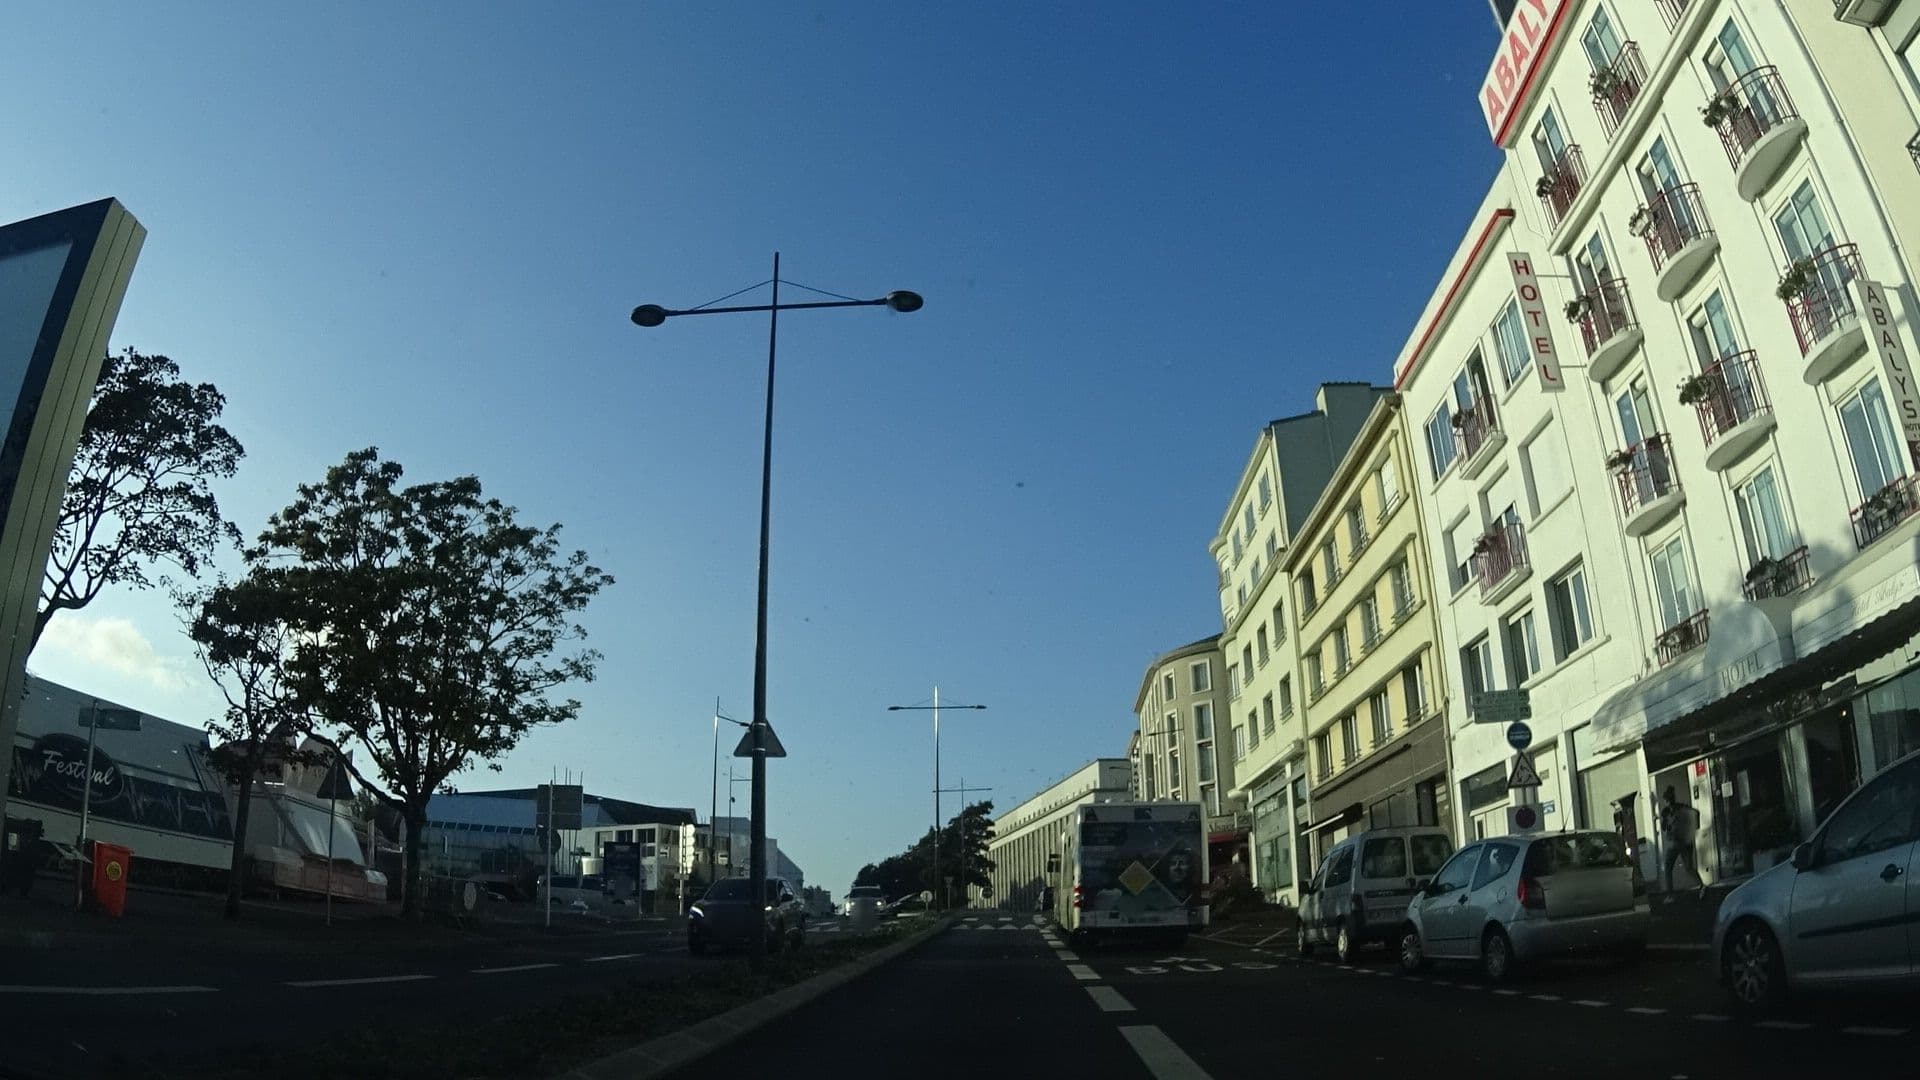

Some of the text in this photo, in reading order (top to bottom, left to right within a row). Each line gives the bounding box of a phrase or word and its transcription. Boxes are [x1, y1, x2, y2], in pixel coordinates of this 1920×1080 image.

[1513, 259, 1557, 382] HOTEL
[1867, 285, 1919, 419] ABALYS
[1722, 652, 1764, 689] HOTEL
[42, 749, 114, 786] Festival
